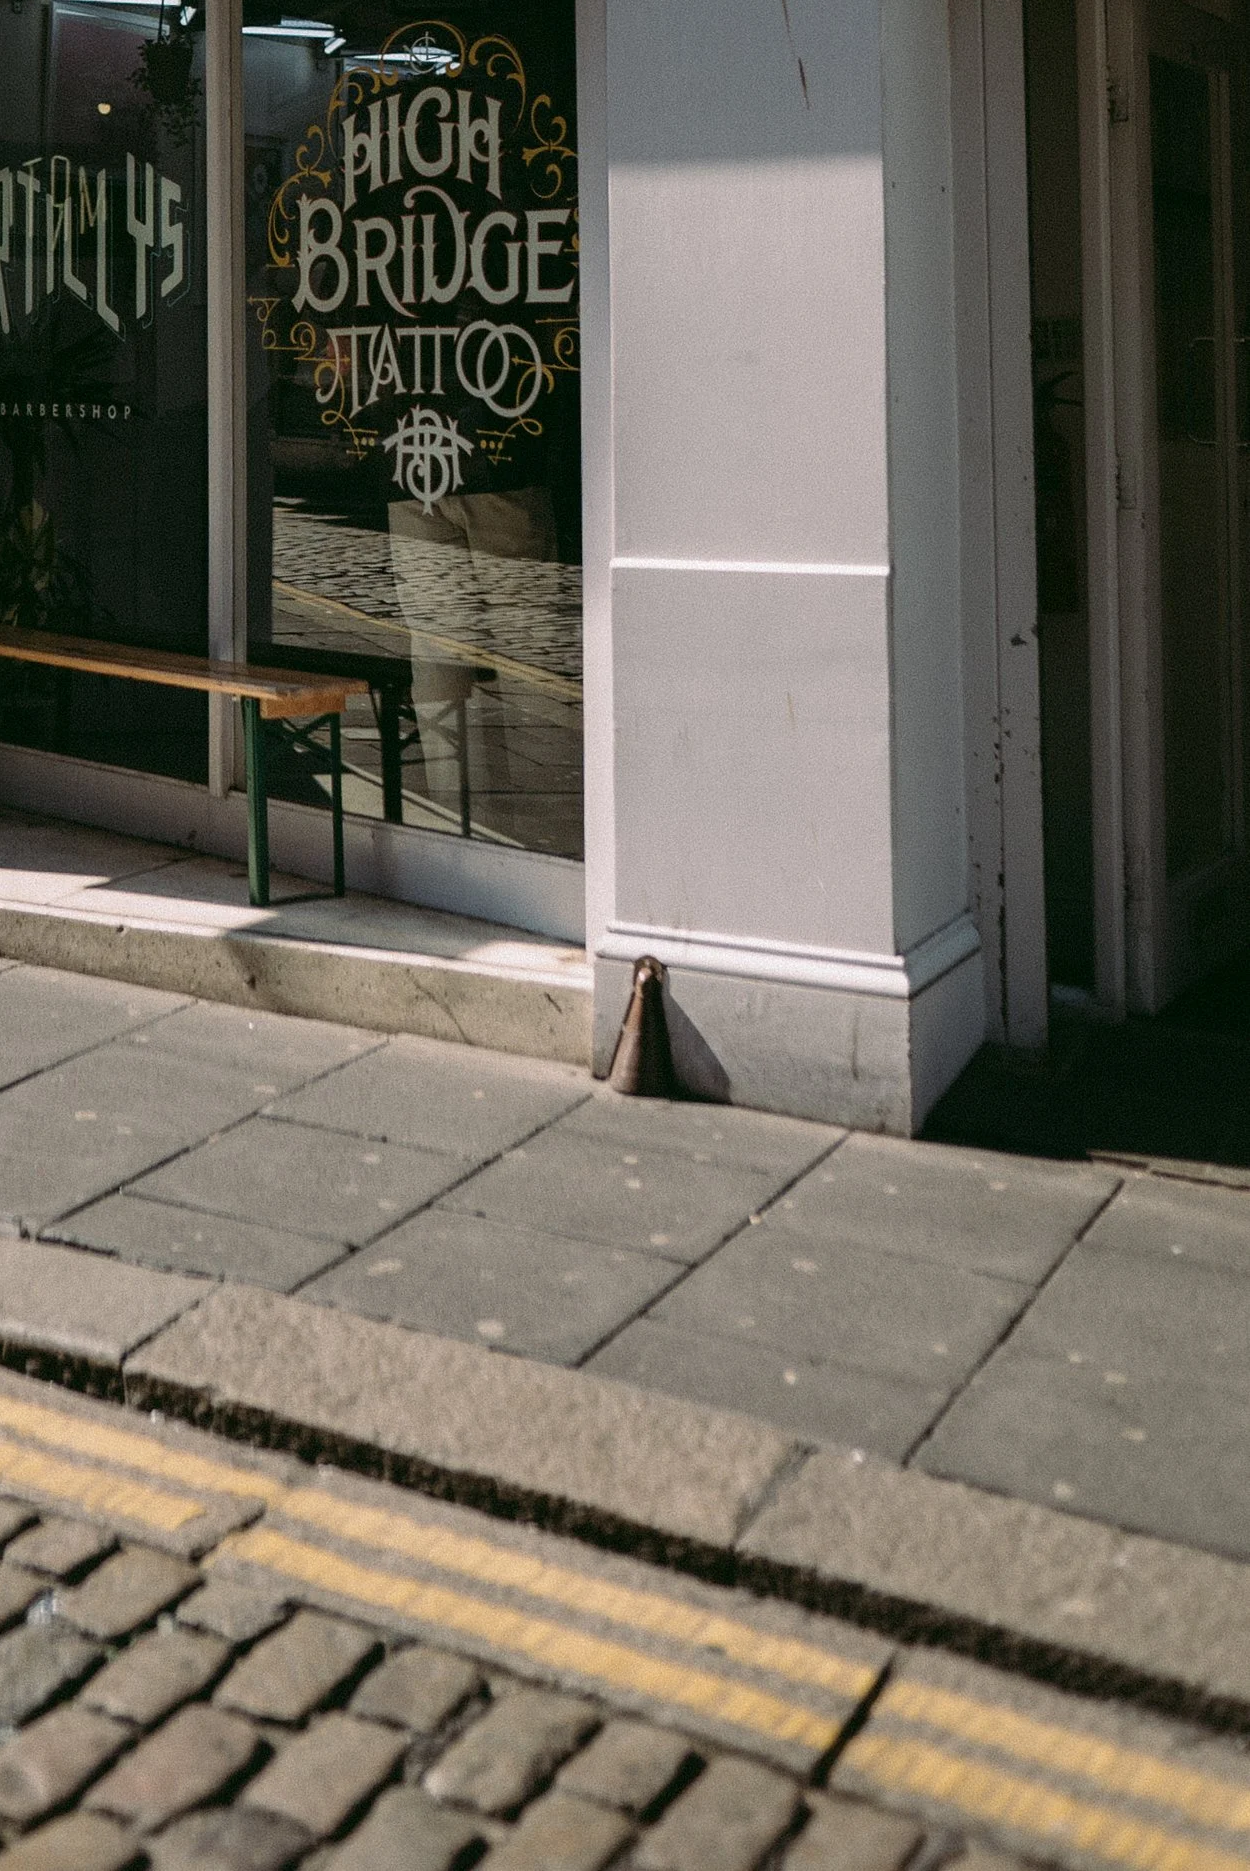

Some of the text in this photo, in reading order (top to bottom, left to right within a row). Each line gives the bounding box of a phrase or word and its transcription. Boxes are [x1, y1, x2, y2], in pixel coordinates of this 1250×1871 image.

[341, 86, 503, 212] HIGH
[291, 185, 576, 318] BRIDGE
[0, 403, 132, 420] BARBERSHOP
[315, 320, 543, 419] TATTOO
